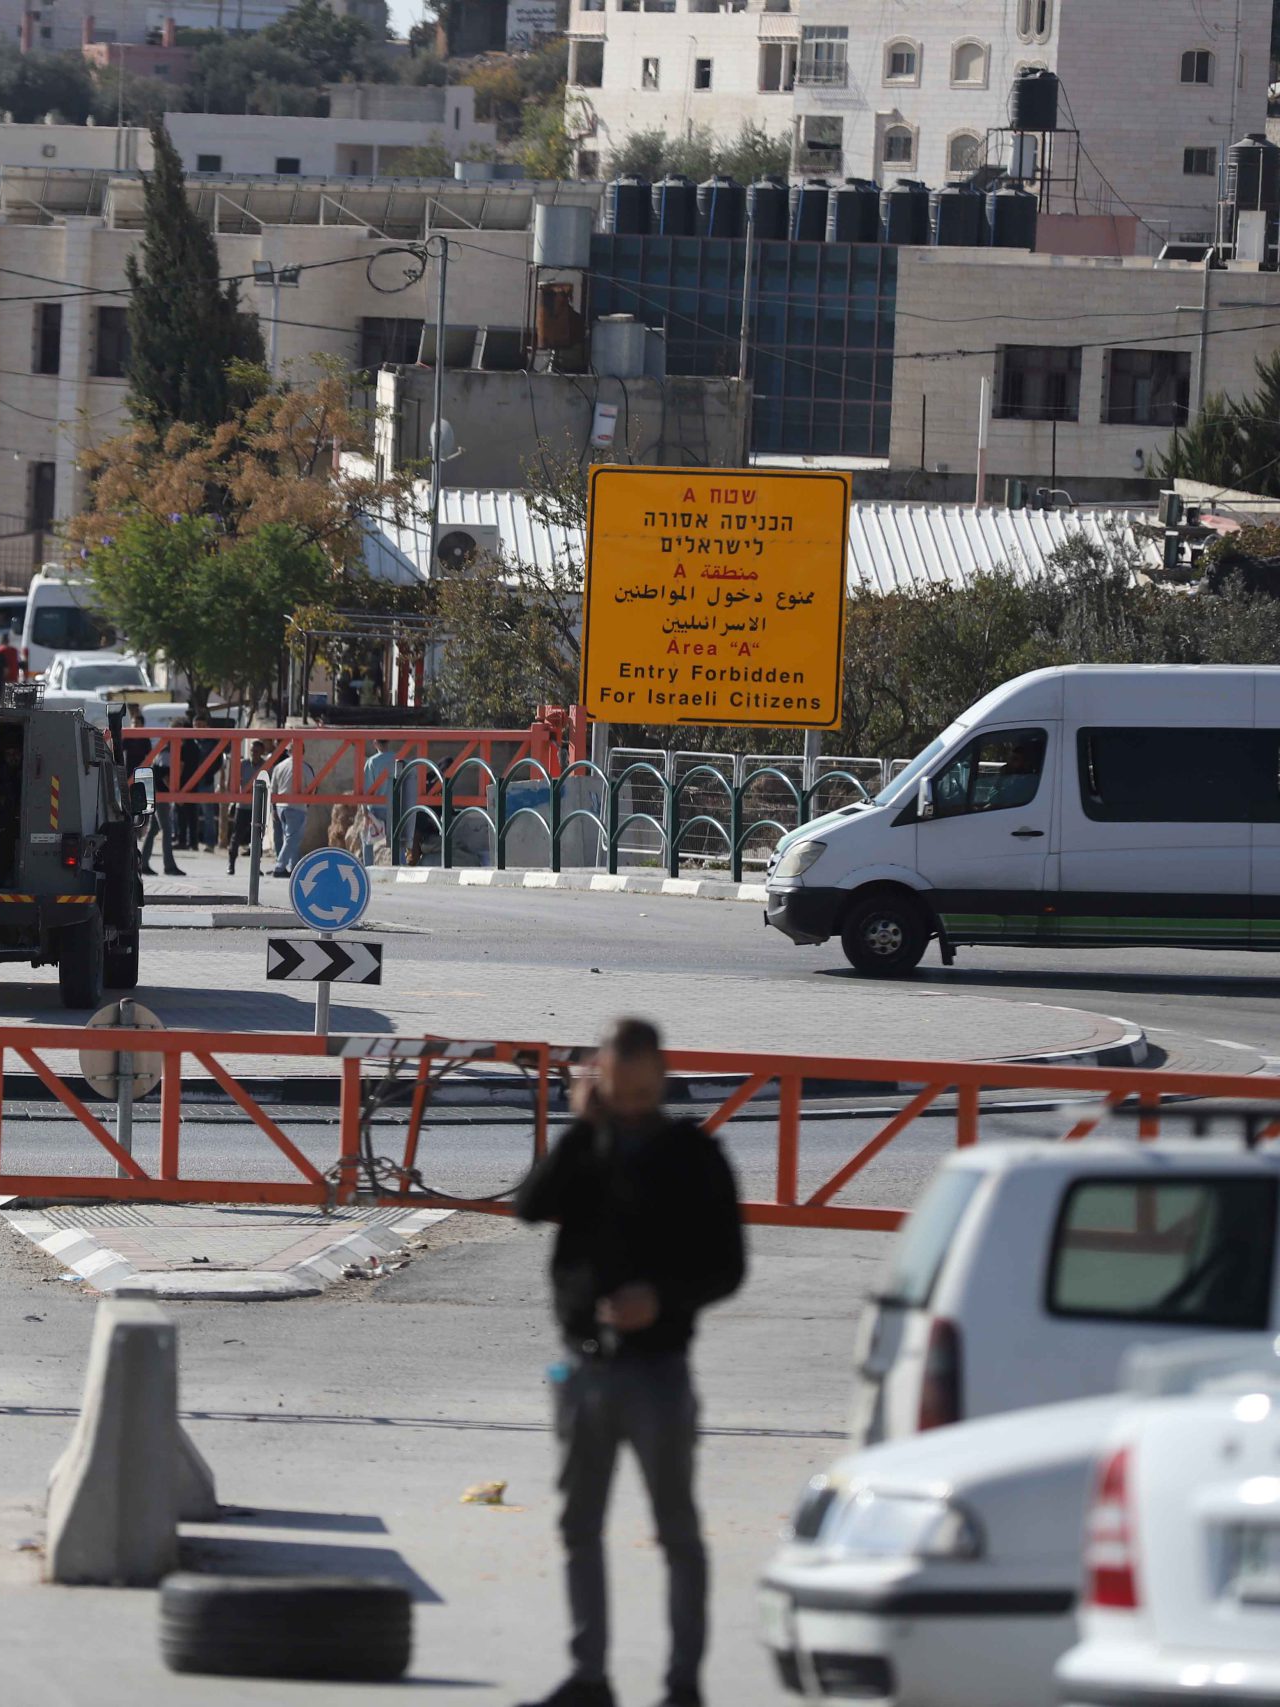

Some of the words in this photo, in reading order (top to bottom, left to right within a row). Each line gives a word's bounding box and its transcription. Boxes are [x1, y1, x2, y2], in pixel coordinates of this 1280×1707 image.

[683, 488, 695, 502] A
[710, 488, 756, 504] שטח
[644, 512, 708, 529] אסורה
[721, 514, 792, 531] הכניסה
[661, 536, 763, 556] לישראלים
[674, 564, 686, 578] A
[701, 564, 758, 580] منطقة
[614, 585, 694, 606] المواطنين
[707, 587, 762, 607] دخول
[776, 591, 814, 610] ممنوع
[667, 640, 717, 656] Area
[620, 663, 678, 683] Entry
[692, 665, 804, 683] Forbidden
[600, 688, 635, 703] For
[649, 689, 717, 706] Israeli
[730, 692, 821, 709] Citizens
